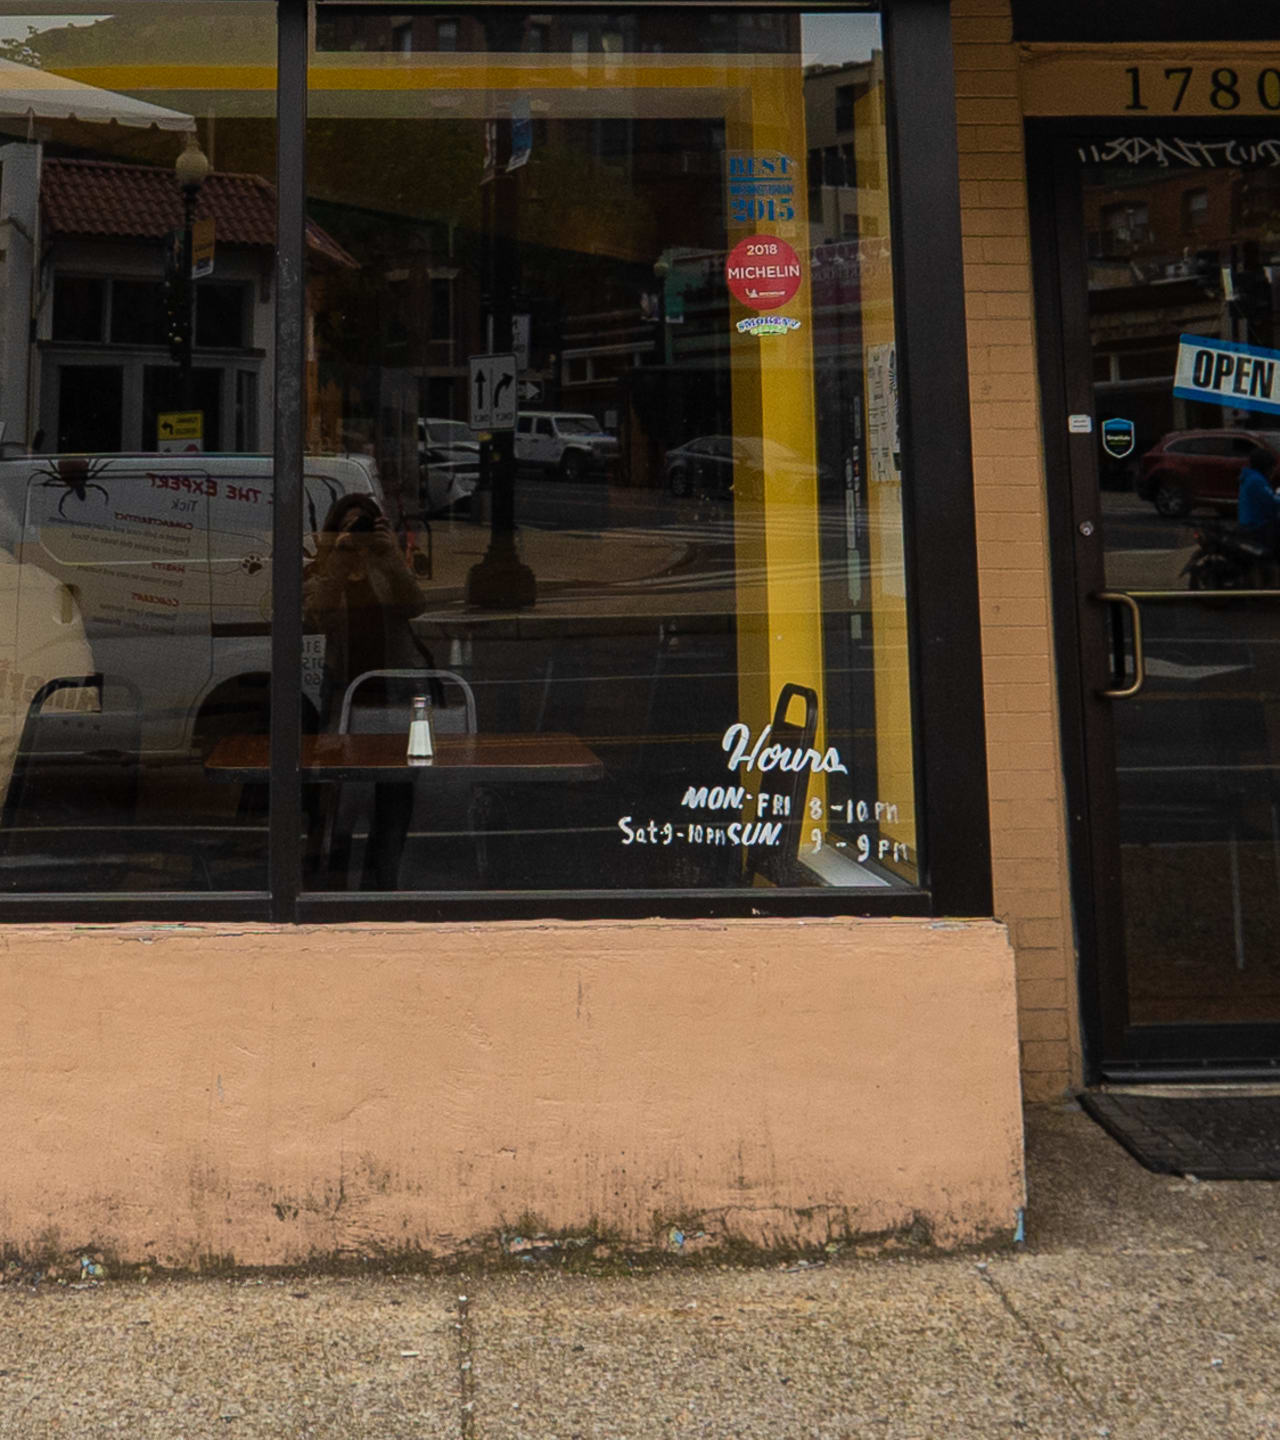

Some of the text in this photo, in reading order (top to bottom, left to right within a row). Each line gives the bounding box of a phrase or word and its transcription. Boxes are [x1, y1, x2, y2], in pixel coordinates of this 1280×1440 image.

[730, 197, 795, 221] 2015
[746, 244, 778, 256] 2018
[727, 265, 800, 279] MICHELIN
[1192, 349, 1275, 399] OPEN
[722, 723, 848, 775] Hours
